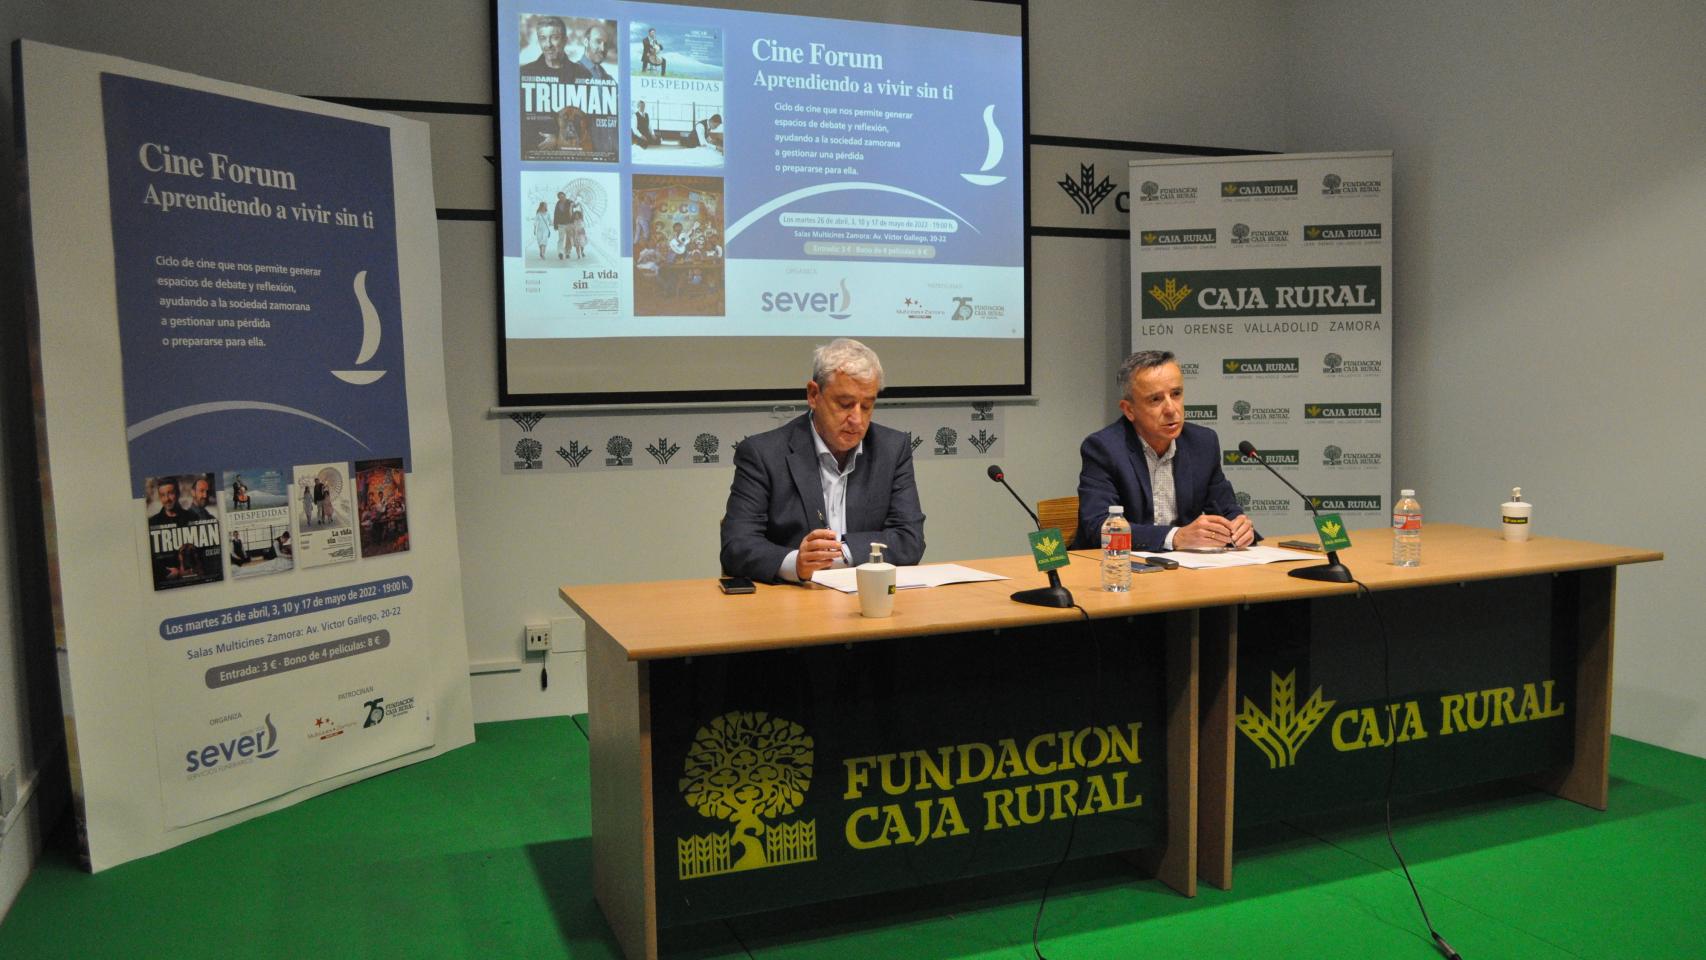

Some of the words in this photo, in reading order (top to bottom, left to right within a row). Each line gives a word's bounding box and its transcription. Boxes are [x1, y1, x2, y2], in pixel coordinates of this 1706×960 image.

[752, 38, 804, 63] Cine
[809, 42, 884, 70] Forum
[641, 78, 720, 92] DESPEDIDAS
[754, 70, 860, 93] Aprendiendo
[864, 83, 872, 94] a
[877, 80, 912, 97] vivir
[917, 82, 938, 99] sin
[943, 84, 953, 100] ti
[522, 82, 616, 116] TRUMAN
[774, 102, 792, 112] Ciclo
[794, 104, 804, 112] de
[806, 104, 820, 113] cine
[823, 106, 838, 115] que
[854, 108, 882, 118] permite
[884, 111, 913, 120] generar
[774, 118, 806, 128] espacios
[808, 120, 818, 128] de
[820, 120, 845, 130] debate
[854, 122, 888, 133] reflexión,
[774, 134, 813, 143] ayudando
[822, 135, 828, 144] la
[830, 136, 862, 146] sociedad
[782, 149, 817, 158] gestionar
[836, 151, 864, 161] pérdida
[139, 143, 204, 177] Cine
[209, 152, 297, 191] Forum
[782, 164, 822, 174] prepararse
[824, 166, 841, 174] para
[844, 165, 858, 175] ella.
[1239, 187, 1262, 195] CAJA
[1264, 186, 1296, 194] RURAL
[144, 184, 272, 218] Aprendiendo
[276, 204, 287, 220] a
[291, 203, 331, 224] vivir
[336, 208, 358, 227] sin
[362, 211, 374, 229] ti
[1159, 236, 1180, 244] CAJA
[1184, 234, 1214, 242] RURAL
[1322, 230, 1344, 238] CAJA
[1348, 229, 1380, 238] RURAL
[156, 256, 179, 266] Ciclo
[182, 258, 194, 268] de
[196, 258, 216, 269] cine
[218, 261, 236, 272] que
[238, 263, 253, 272] nos
[255, 264, 288, 274] permite
[290, 267, 322, 277] generar
[583, 270, 594, 279] La
[598, 270, 618, 278] vida
[157, 276, 198, 288] espacios
[201, 278, 213, 288] de
[216, 279, 246, 290] debate
[248, 283, 254, 292] y
[256, 282, 296, 294] reflexión,
[572, 280, 588, 289] sin
[160, 297, 208, 308] ayudando
[210, 300, 217, 308] a
[219, 298, 228, 308] la
[229, 298, 268, 310] sociedad
[269, 302, 310, 312] zamorana
[762, 292, 838, 312] sever
[1198, 287, 1269, 310] CAJA
[1276, 284, 1376, 308] RURAL
[161, 318, 168, 326] a
[170, 316, 215, 328] gestionar
[218, 319, 234, 327] una
[237, 318, 270, 329] pérdida
[1142, 322, 1174, 336] LEÓN
[1184, 323, 1233, 334] ORENSE
[1244, 322, 1318, 334] VALLADOLID
[1330, 320, 1380, 332] ZAMORA
[172, 337, 223, 348] prepararse
[226, 338, 246, 348] para
[248, 336, 266, 347] ella.
[1240, 364, 1263, 372] CAJA
[1266, 363, 1298, 371] RURAL
[1322, 500, 1344, 508] CAJA
[234, 508, 287, 520] DESPEDIDAS
[151, 524, 220, 553] TRUMAN
[166, 624, 183, 635] Los
[186, 618, 219, 631] martes
[221, 613, 232, 624] 26
[234, 612, 246, 622] de
[248, 606, 270, 619] abril,
[272, 604, 280, 616] 3,
[282, 602, 292, 613] 10
[294, 604, 300, 614] y
[302, 600, 311, 608] 17
[312, 598, 323, 608] de
[324, 594, 346, 605] mayo
[348, 590, 358, 600] de
[360, 586, 376, 598] 2022
[382, 582, 400, 593] 19:00
[402, 580, 408, 590] h.
[186, 648, 214, 660] Salas
[216, 636, 264, 654] Multicines
[267, 630, 304, 643] Zamora:
[306, 626, 320, 634] Av.
[348, 613, 379, 626] Gallego,
[381, 607, 401, 618] 20-22
[220, 666, 260, 682] Entrada:
[262, 662, 268, 672] 3
[270, 660, 277, 669] €
[284, 655, 307, 666] Bono
[309, 651, 320, 660] de
[322, 648, 327, 657] 4
[329, 640, 366, 658] películas:
[368, 638, 372, 646] 8
[375, 636, 380, 645] €
[210, 712, 242, 726] ORGANIZA
[1332, 701, 1428, 752] CAJA
[1440, 680, 1564, 736] RURAL
[186, 731, 265, 772] sever
[842, 722, 1142, 800] FUNDACION
[846, 796, 969, 850] CAJA
[983, 772, 1142, 831] RURAL
